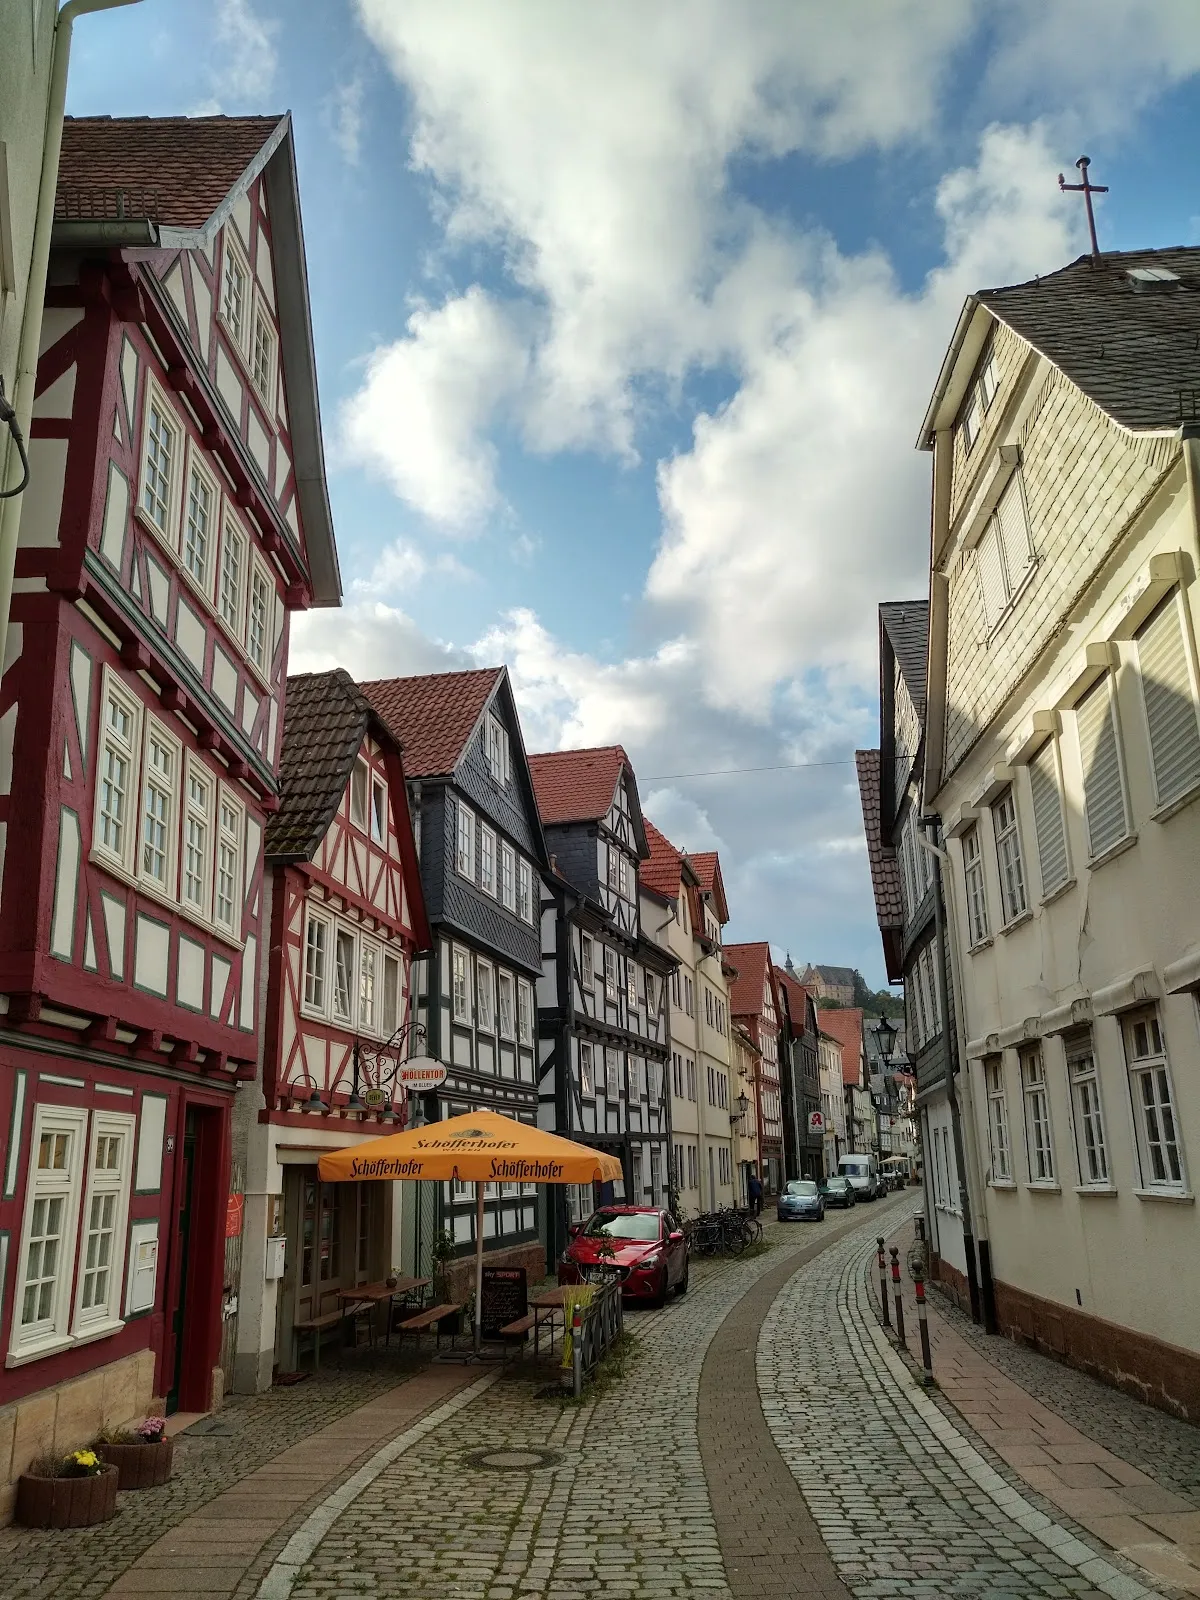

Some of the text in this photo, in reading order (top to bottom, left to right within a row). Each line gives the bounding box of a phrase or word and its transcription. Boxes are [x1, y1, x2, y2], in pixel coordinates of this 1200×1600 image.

[401, 1068, 444, 1081] HÖLLENTOR
[412, 1139, 519, 1149] Schöfferhofer
[350, 1158, 424, 1178] Schöfferhofer
[489, 1158, 564, 1178] Schöfferhofer
